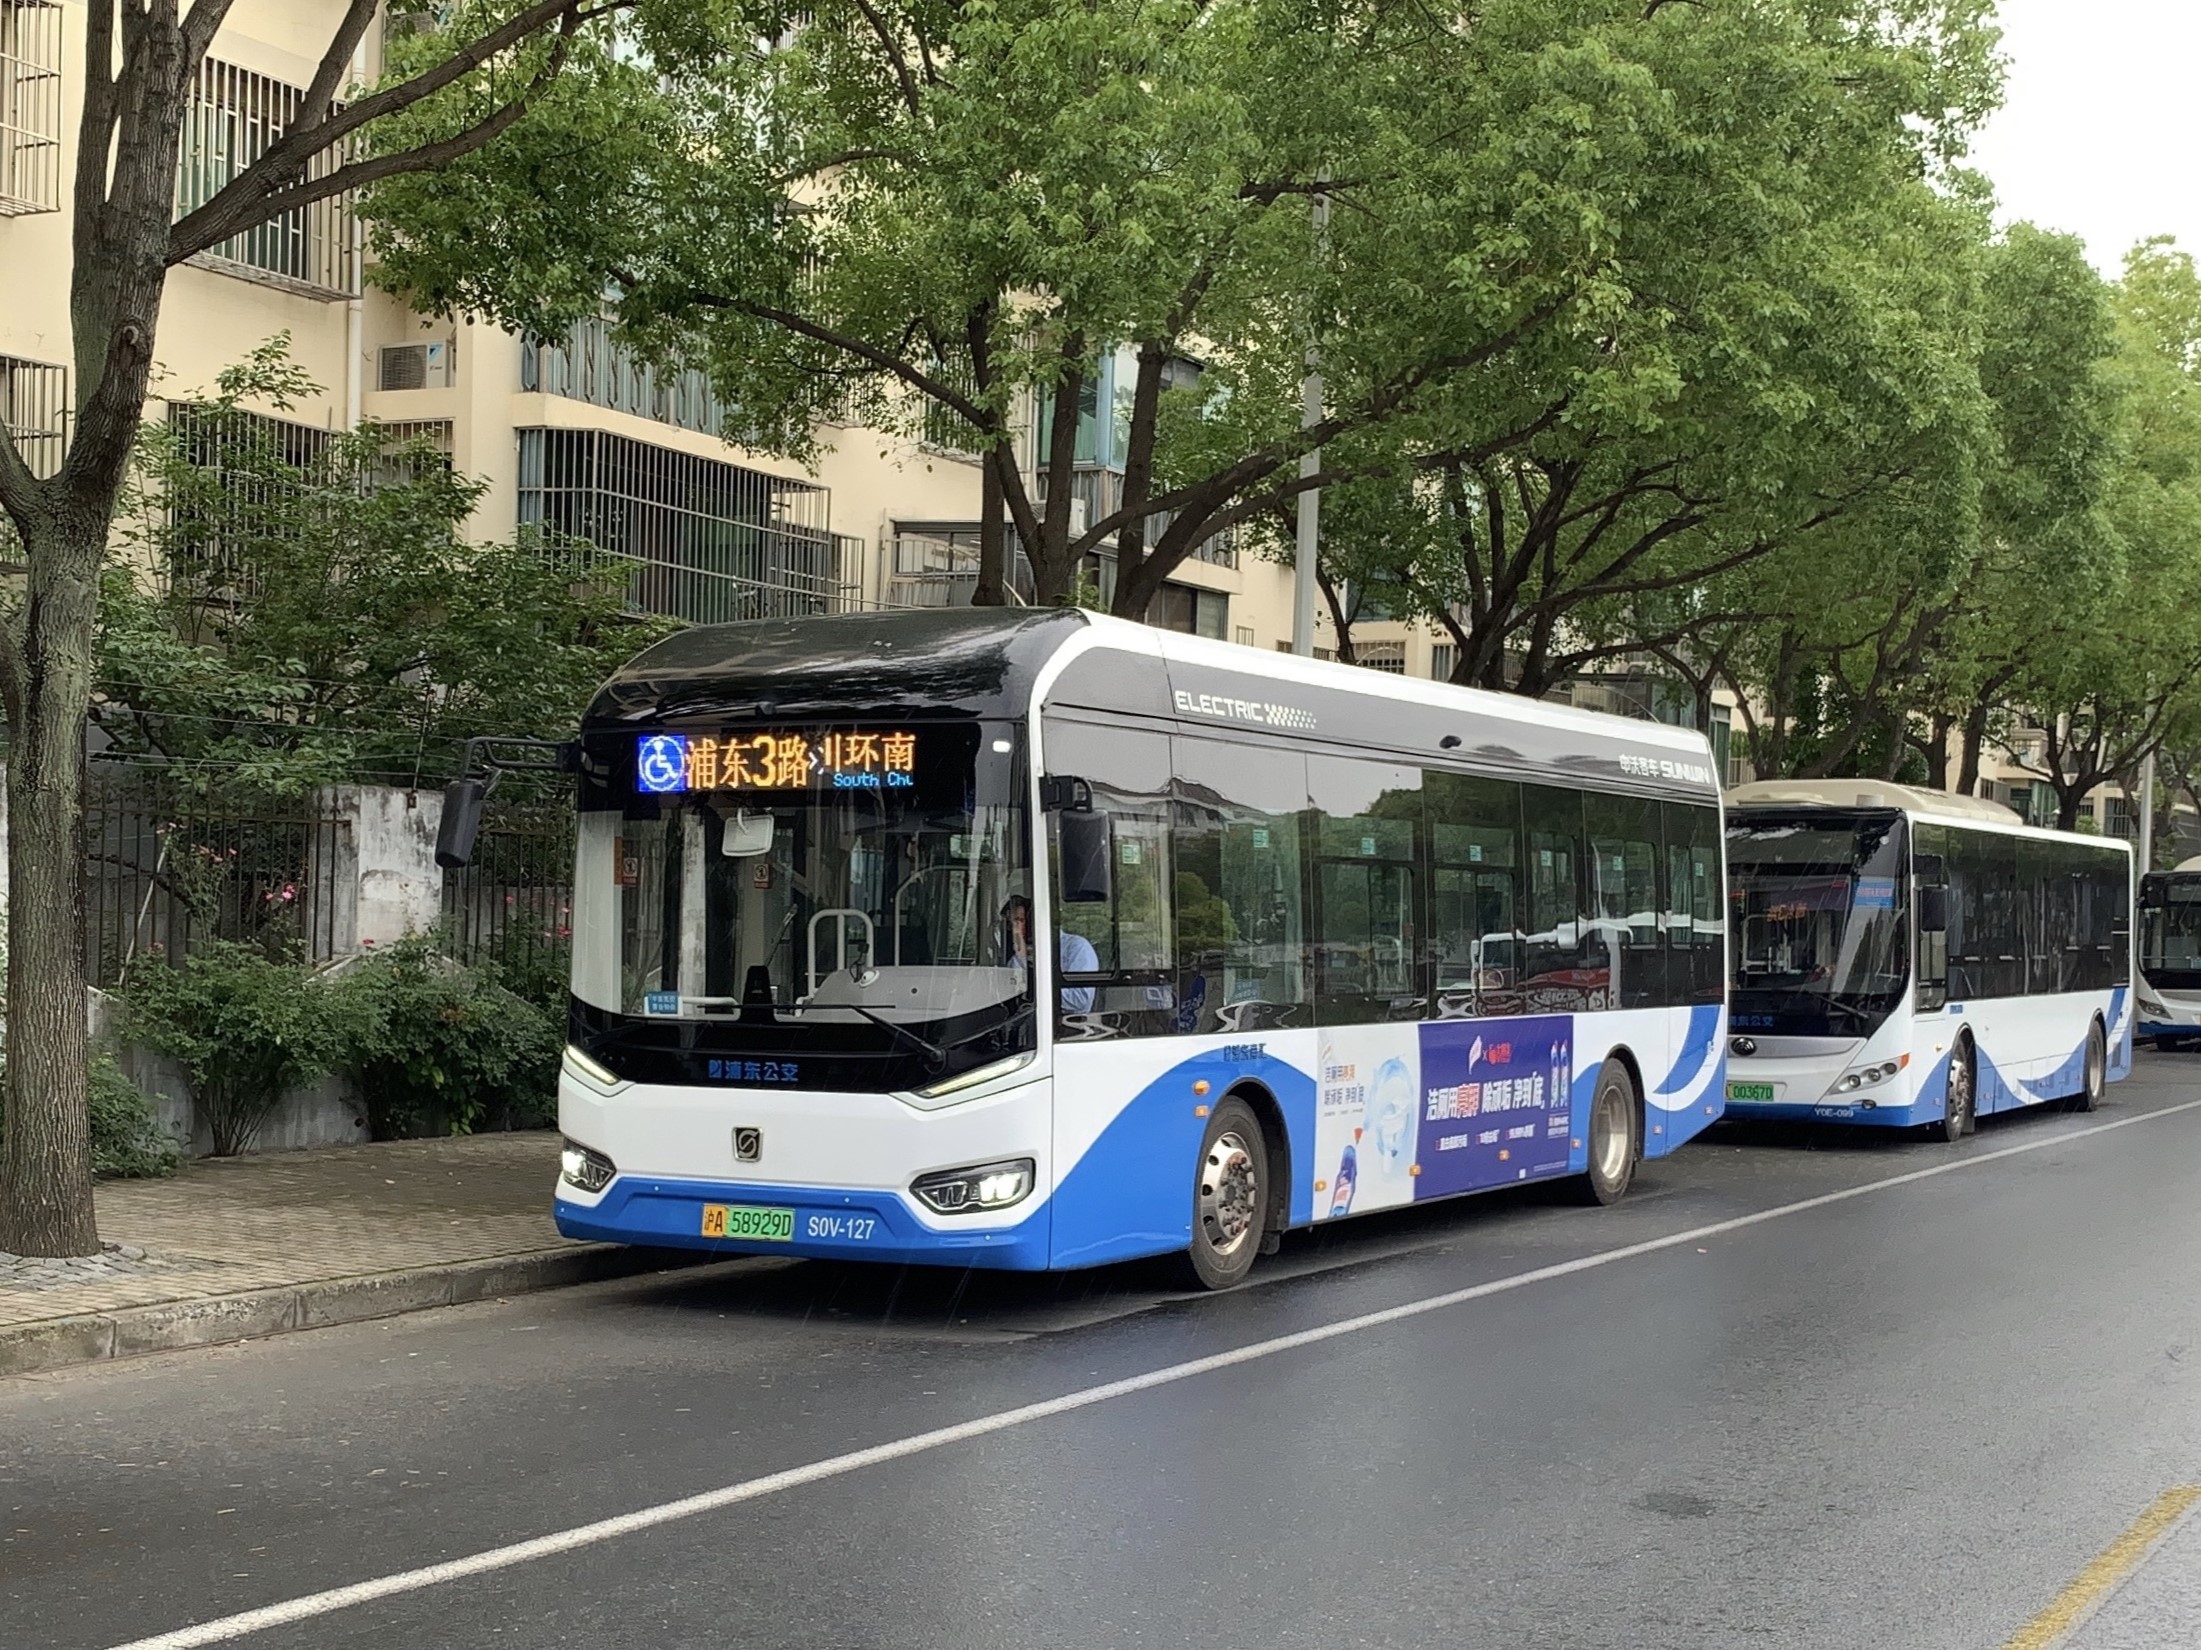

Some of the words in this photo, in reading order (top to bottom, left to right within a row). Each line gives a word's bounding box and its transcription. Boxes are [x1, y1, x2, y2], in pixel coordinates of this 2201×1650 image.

[1174, 690, 1264, 722] ELECTRIC
[685, 734, 809, 789] 浦东3路
[832, 772, 880, 787] South
[725, 1059, 799, 1081] 浦东公交
